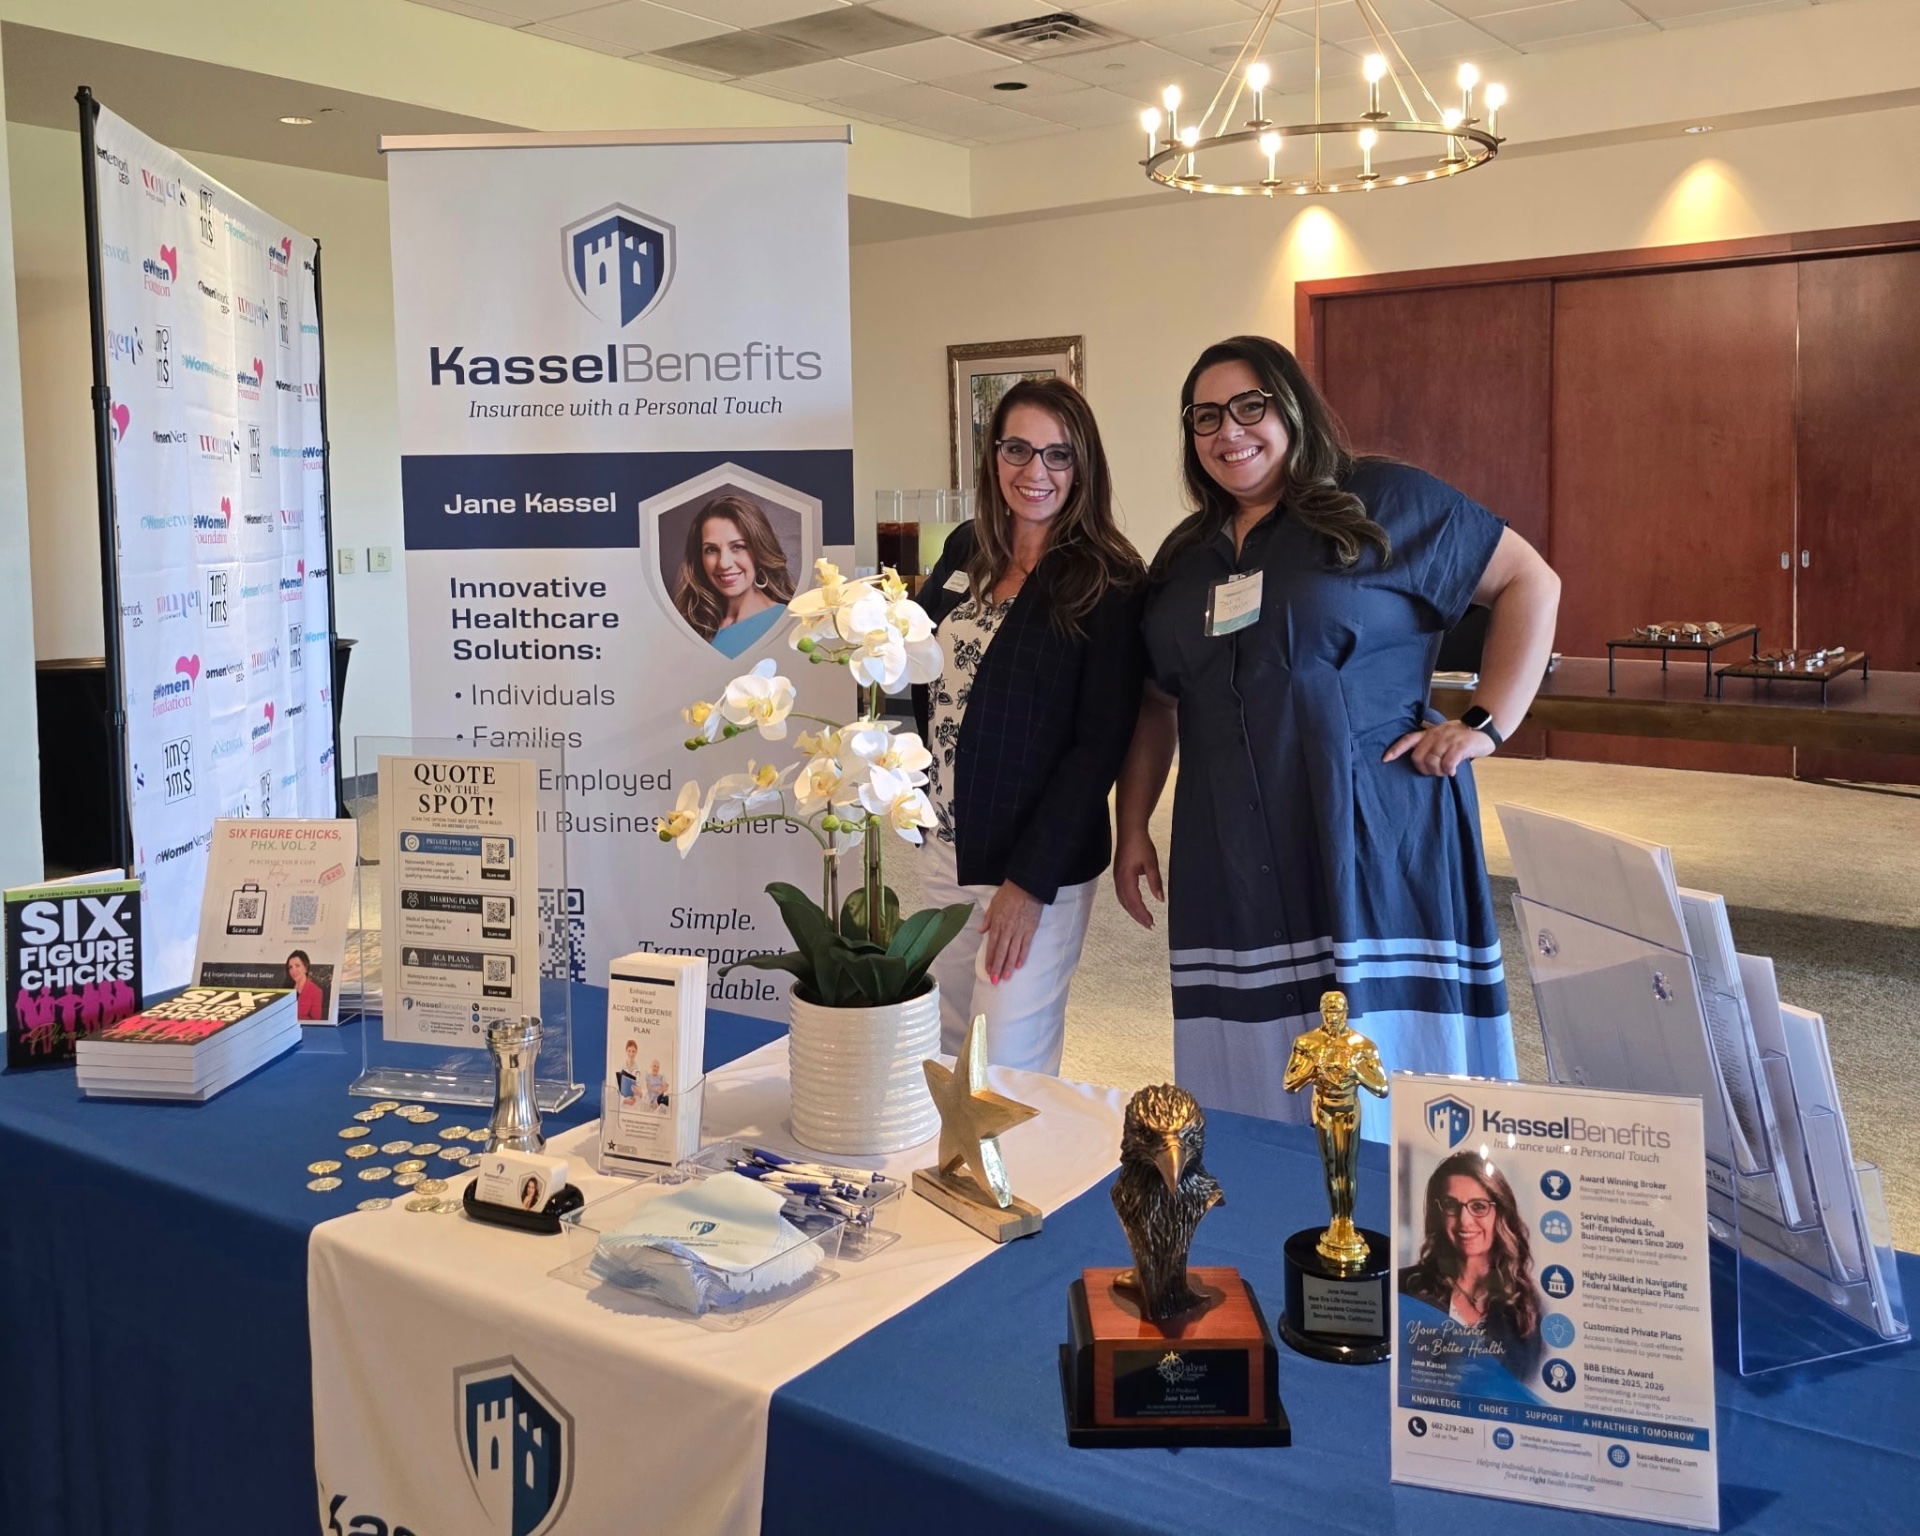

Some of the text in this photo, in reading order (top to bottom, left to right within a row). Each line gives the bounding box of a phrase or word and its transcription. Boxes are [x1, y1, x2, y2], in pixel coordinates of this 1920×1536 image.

[430, 341, 822, 385] KasselBenefits
[469, 396, 783, 419] Insurance with a Personal Touch
[444, 492, 617, 514] Jane Kassel
[450, 577, 607, 599] Innovative
[451, 607, 619, 629] Healthcare
[453, 639, 602, 661] Solutions:
[471, 684, 615, 706] Individuals
[473, 726, 582, 749] Families
[414, 764, 496, 785] QUOTE
[539, 769, 672, 796] Employed
[434, 784, 480, 795] ON THE
[419, 794, 493, 816] SPOT!
[556, 811, 673, 833] Busines
[229, 829, 341, 841] SIX FIGURE CHICKS,
[251, 841, 317, 850] PHX. VOL. 2
[326, 868, 342, 880] $20
[38, 890, 86, 898] INTERNATIONAL
[430, 895, 479, 905] SHARING PLANS
[21, 895, 132, 945] SIX-
[670, 908, 755, 935] Simple.
[20, 938, 134, 970] FIGURE
[432, 954, 470, 963] ACA PLANS
[21, 961, 134, 990] CHICKS
[630, 988, 656, 996] Enhanced
[707, 978, 779, 1001] dable.
[141, 1010, 243, 1022] CHICKS
[150, 1002, 258, 1016] FIGURE
[612, 1004, 672, 1017] ACCIDENT EXPENSE
[624, 1015, 660, 1025] INSURANCE
[634, 1026, 650, 1034] PLAN
[1483, 1109, 1671, 1149] KasselBenefits
[1494, 1138, 1544, 1153] Insrance
[1580, 1147, 1625, 1160] Personal
[1627, 1151, 1660, 1163] Touch
[1580, 1175, 1666, 1190] Award Winning Broker
[1581, 1212, 1655, 1227] Serving Individuals,
[1581, 1223, 1635, 1235] Self-Employed
[1645, 1229, 1664, 1238] Small
[1581, 1232, 1684, 1249] Business Owners Since 2009
[1582, 1270, 1687, 1291] Highly Skilled in Navigating
[1582, 1281, 1684, 1299] Federal Marketplace Plans
[1406, 1319, 1487, 1344] Your Partner
[1583, 1321, 1682, 1340] Customized Private Plans
[1417, 1339, 1506, 1358] in Better Health
[1411, 1359, 1447, 1369] Jane Kassel
[1584, 1363, 1654, 1379] BBB Ethics Award
[1584, 1374, 1664, 1391] Nominee 2025, 2026
[1411, 1394, 1461, 1408] KNOWLEDGE
[1479, 1404, 1509, 1415] CHOICE
[1526, 1410, 1563, 1423] SUPPORT
[1592, 1420, 1639, 1434] HEALTHIER
[1642, 1426, 1694, 1441] TOMORROW
[1431, 1421, 1474, 1434] 602-279-5263
[1636, 1452, 1697, 1467] kasselbenefits.com
